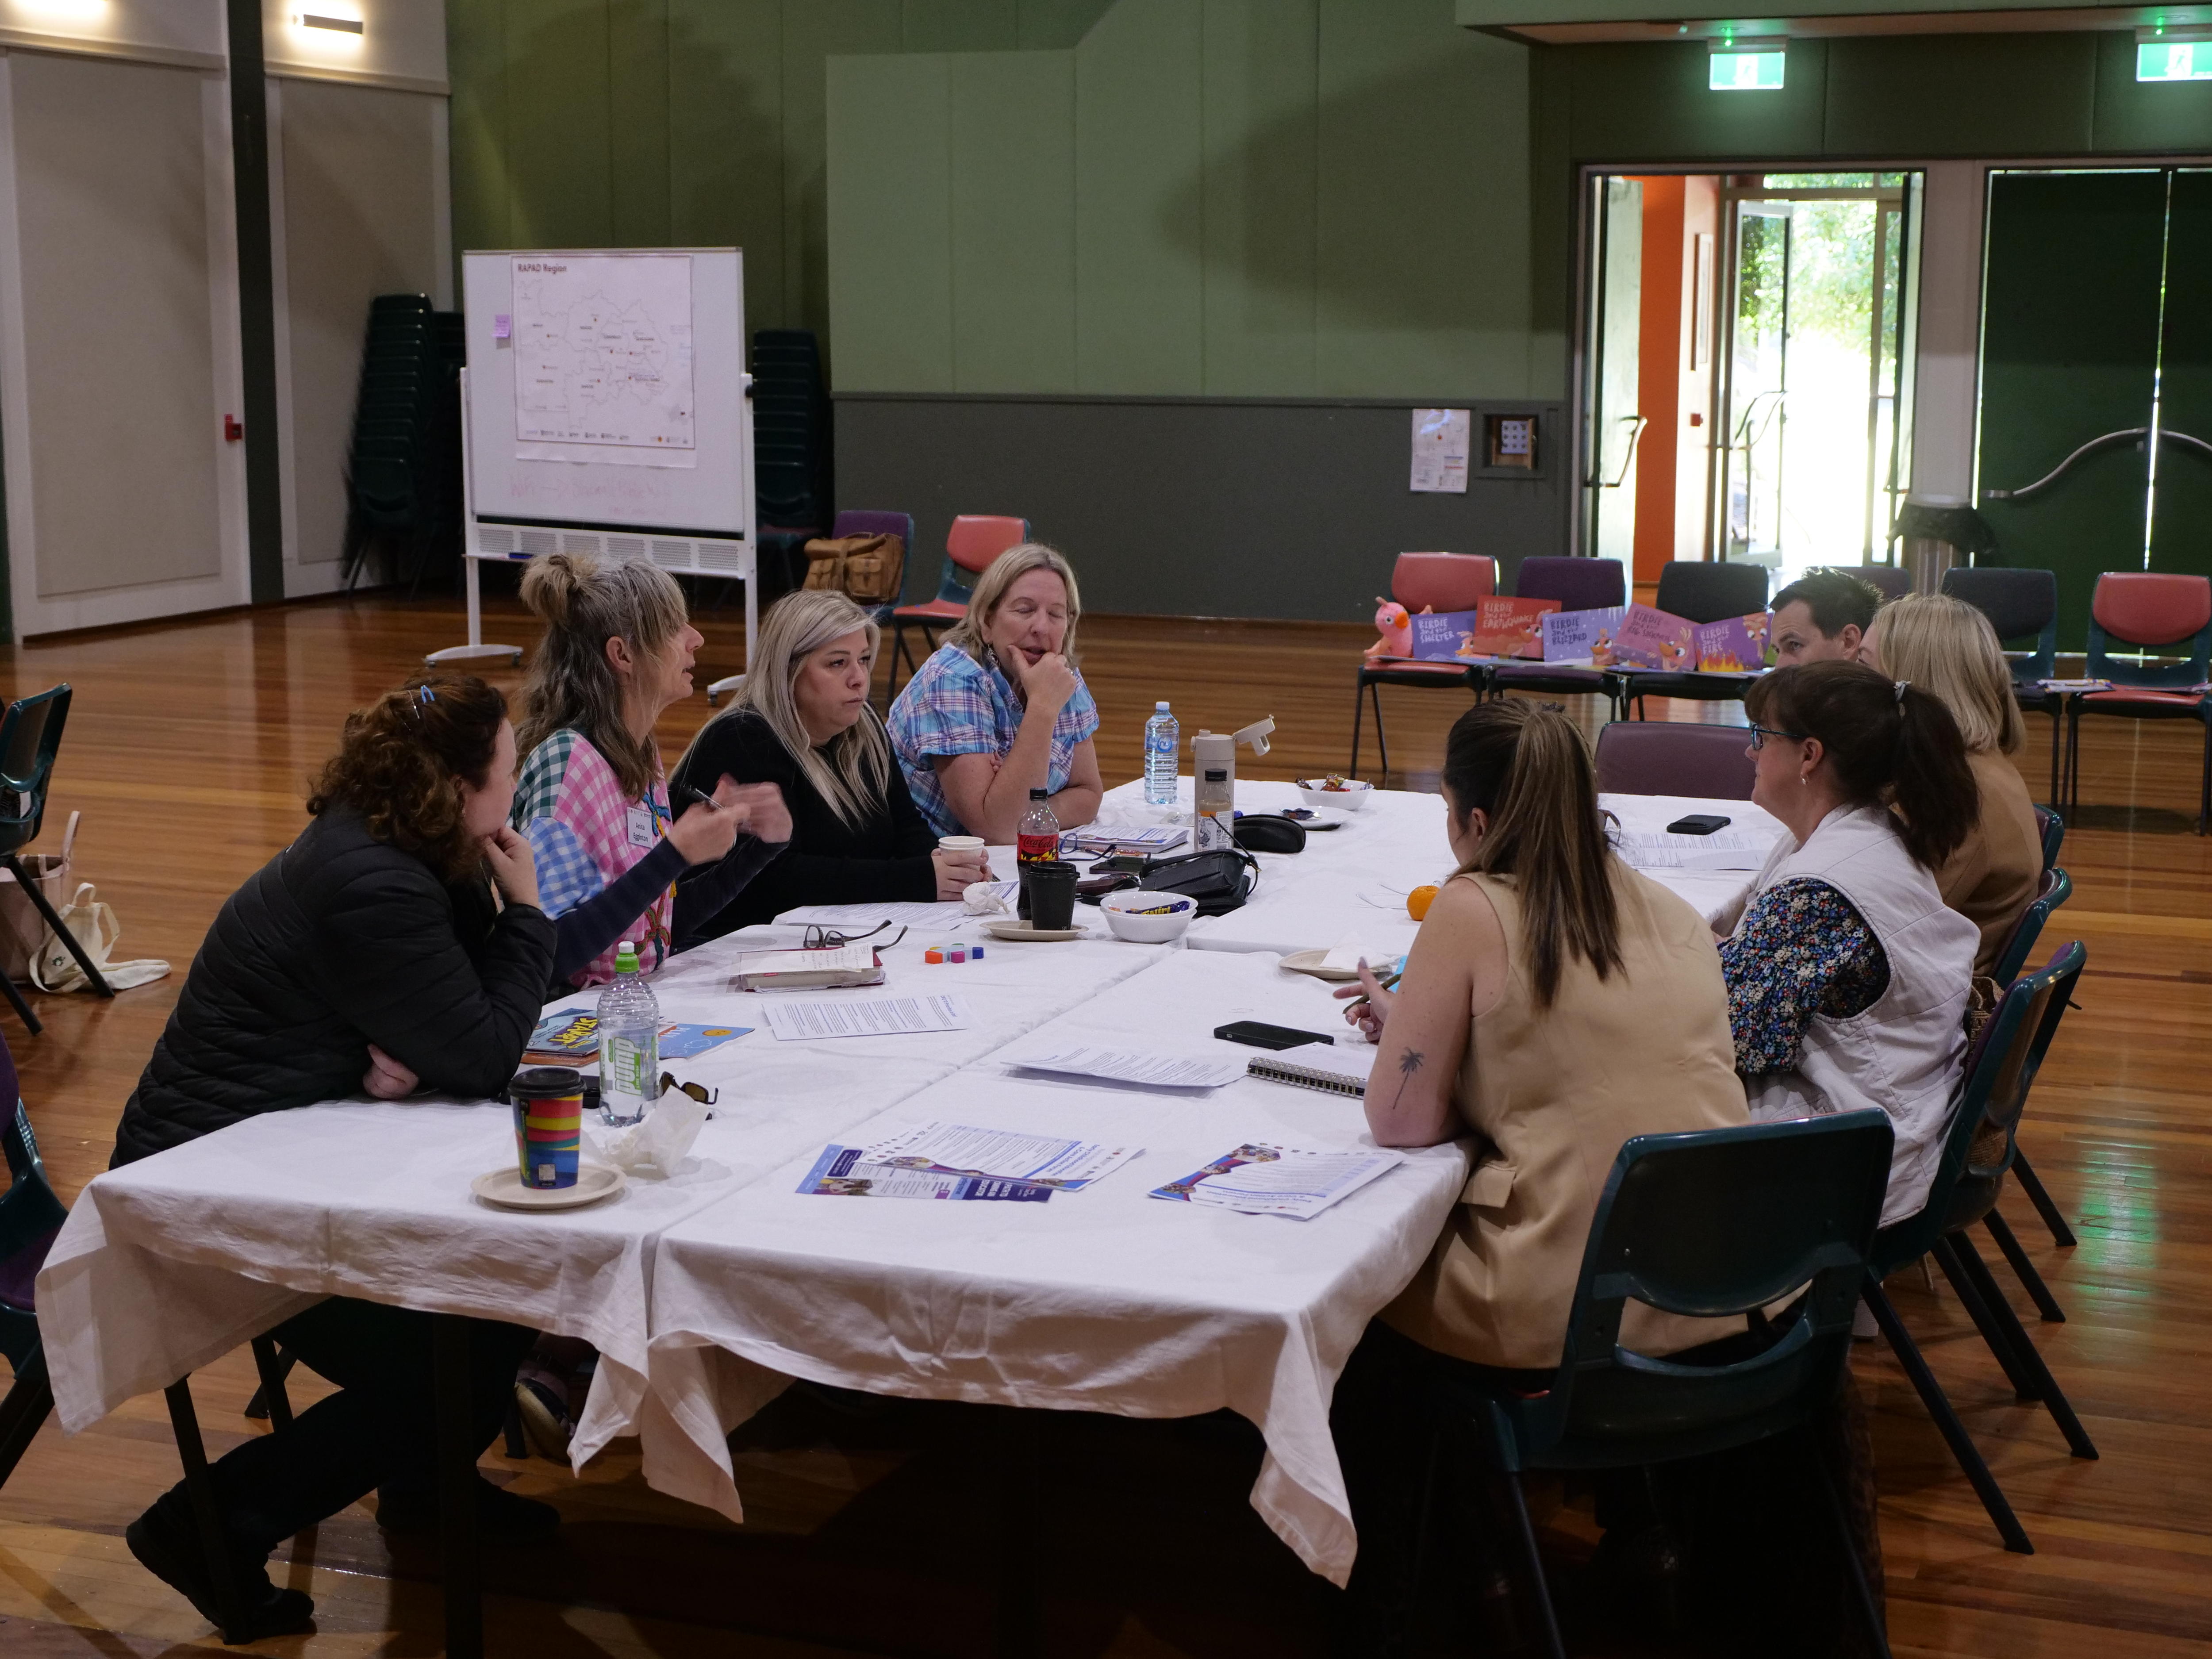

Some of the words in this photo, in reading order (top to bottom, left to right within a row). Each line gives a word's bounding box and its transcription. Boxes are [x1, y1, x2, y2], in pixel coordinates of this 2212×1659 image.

[1484, 603, 1513, 611] BIRDIE
[1418, 618, 1448, 629] BIRDIE
[1551, 618, 1579, 629] BIRDIE
[1633, 611, 1662, 626] BIRDIE
[1420, 631, 1455, 643] SHELTER
[1552, 633, 1587, 645] BLIZZARD
[1700, 626, 1730, 641] BIRDIE
[1703, 641, 1722, 655] FIRE
[634, 832, 648, 842] Egginton
